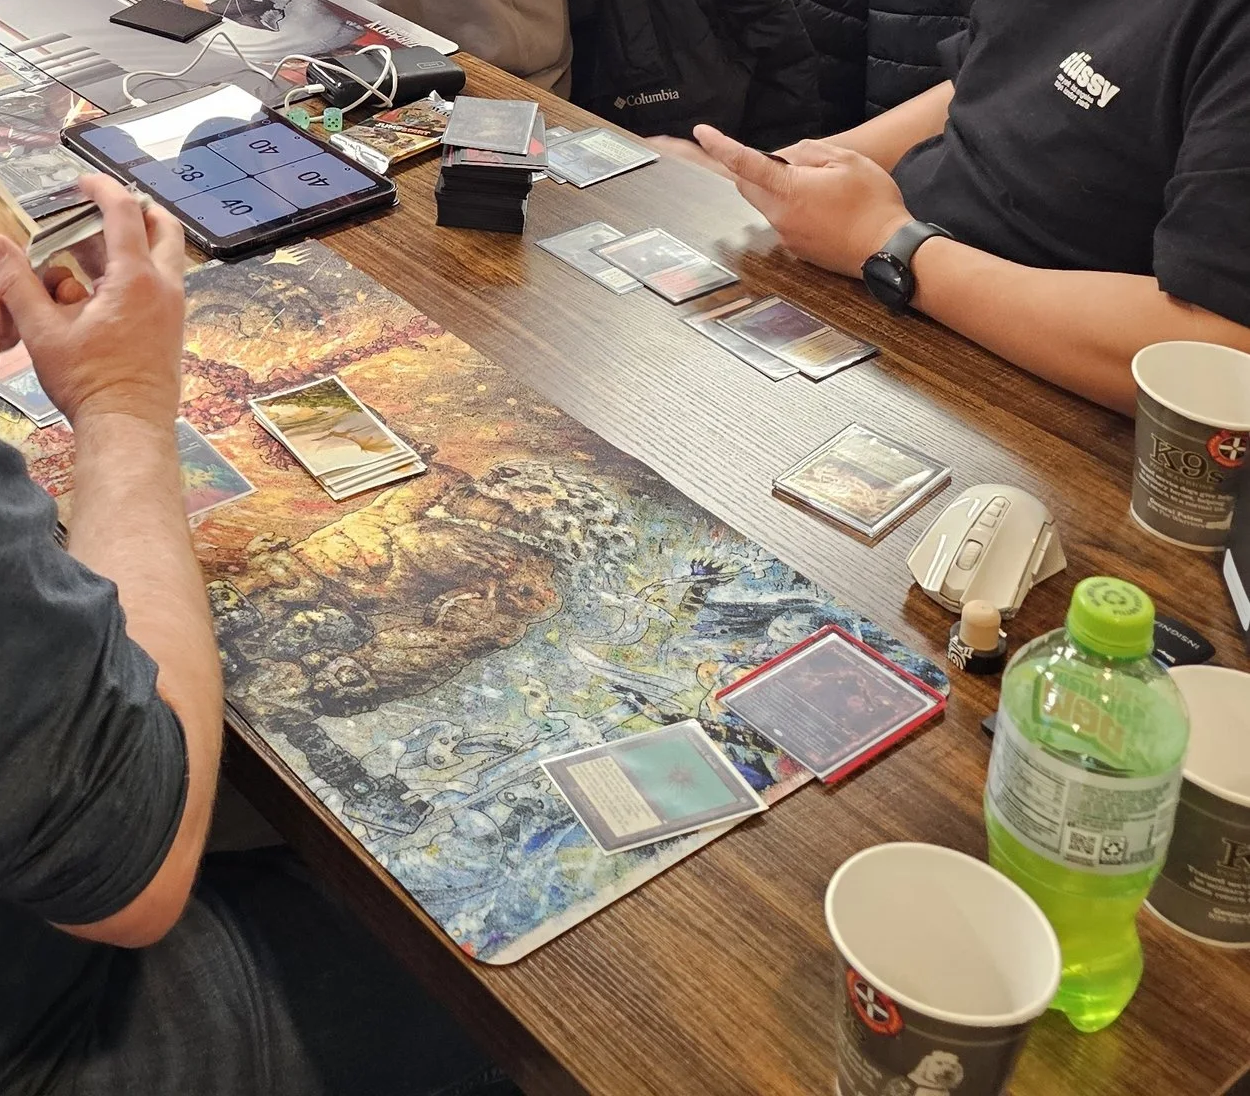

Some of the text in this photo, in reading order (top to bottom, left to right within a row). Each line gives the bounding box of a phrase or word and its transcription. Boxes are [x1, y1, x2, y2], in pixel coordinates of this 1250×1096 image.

[626, 88, 680, 107] Columbia
[249, 139, 280, 155] 40
[171, 164, 205, 182] 38
[298, 171, 330, 188] 40
[221, 199, 253, 216] 40
